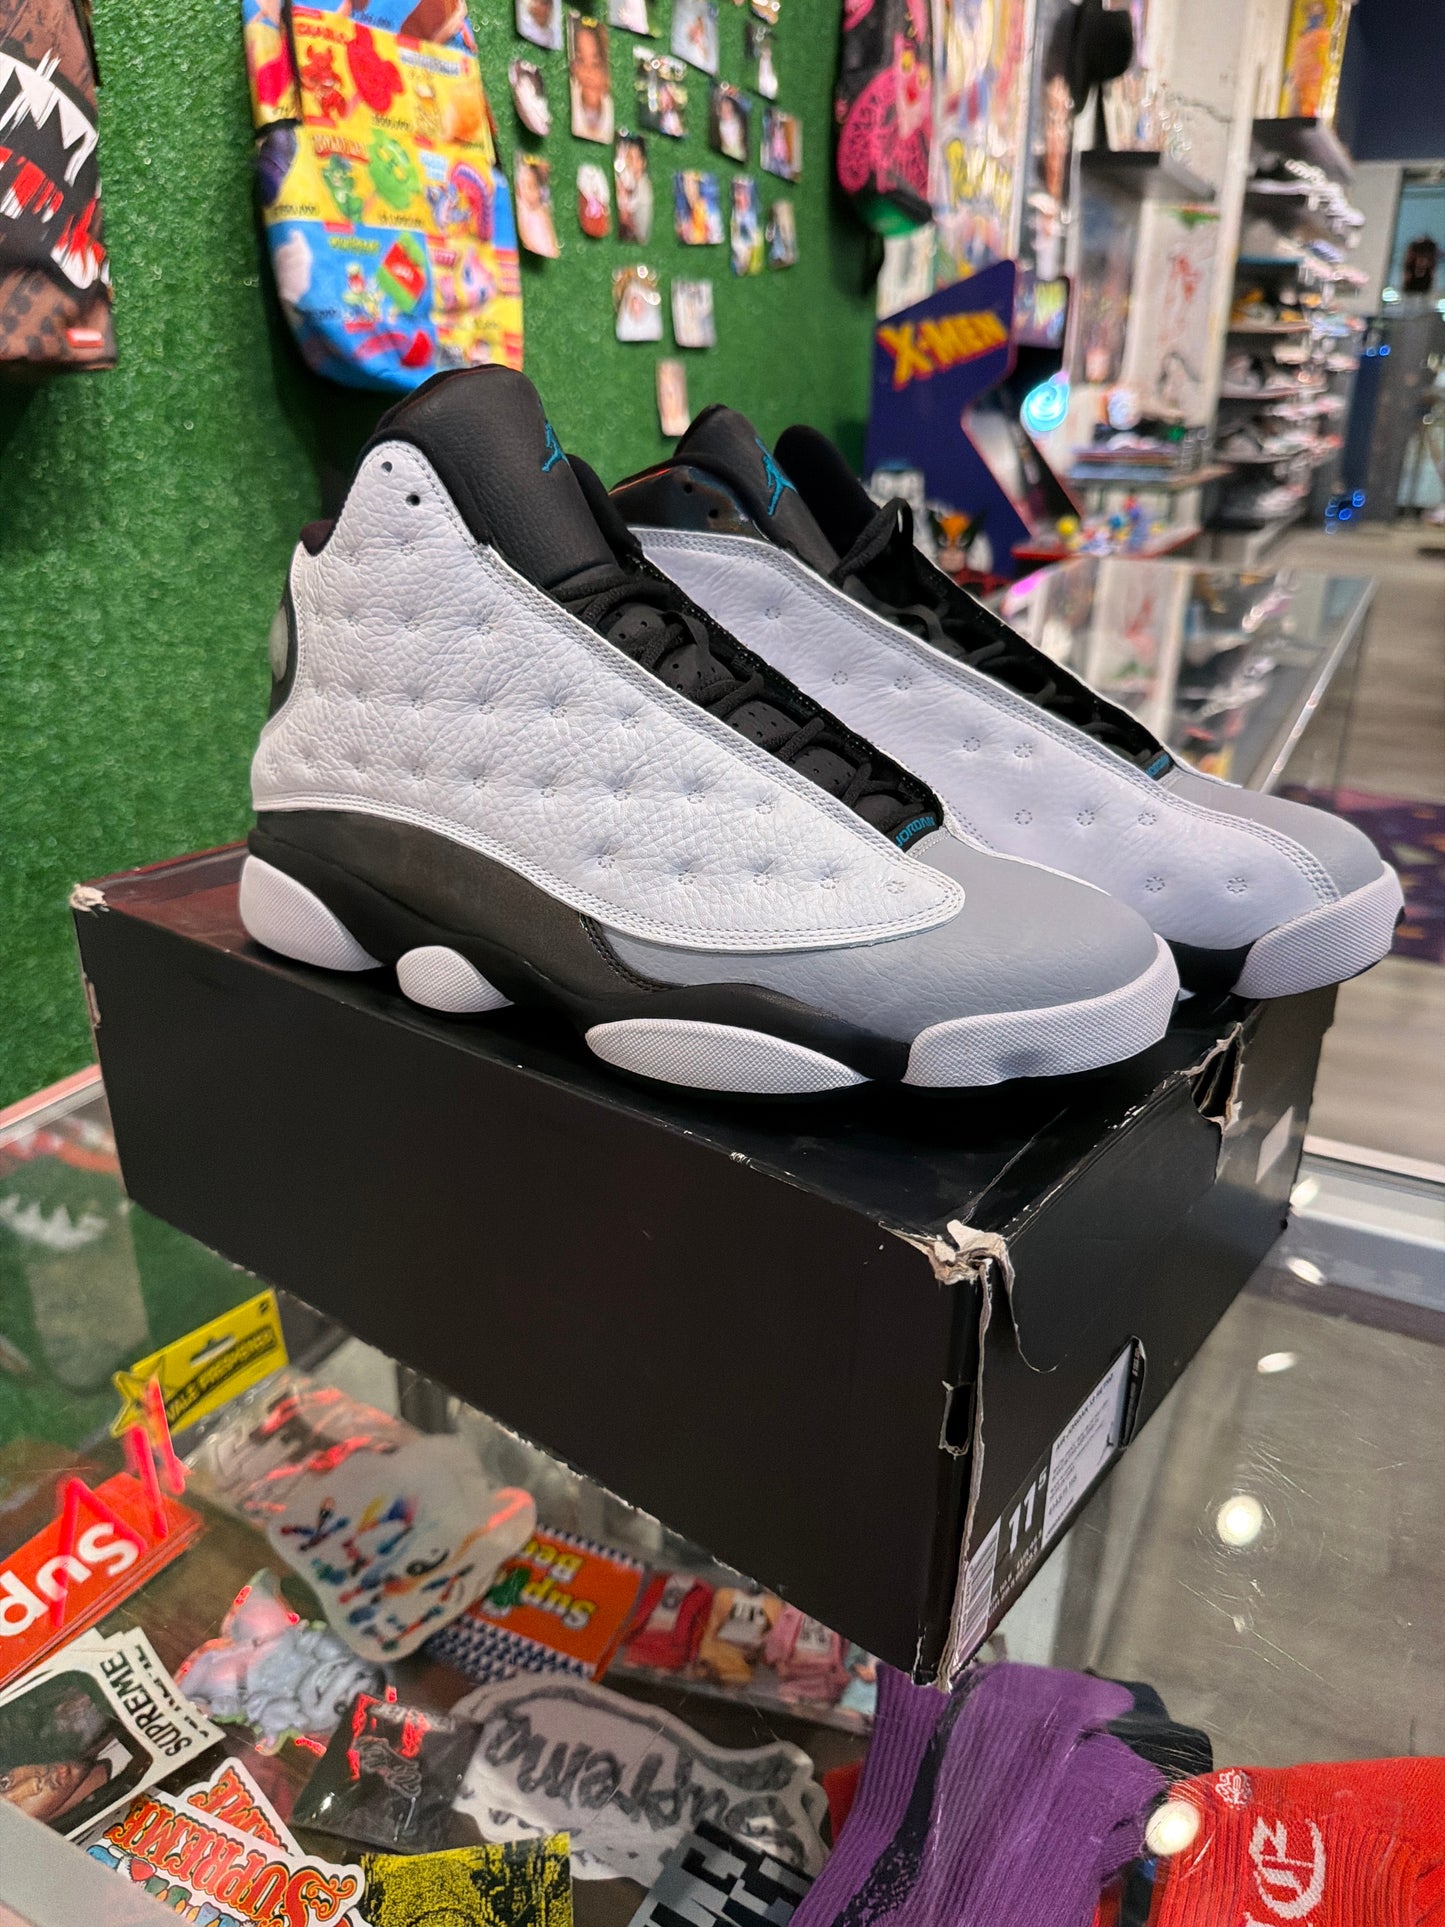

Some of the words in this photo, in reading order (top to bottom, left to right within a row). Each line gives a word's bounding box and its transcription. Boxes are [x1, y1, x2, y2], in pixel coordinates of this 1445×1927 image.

[876, 310, 1008, 391] X-MEN
[895, 815, 936, 847] JORDAN
[99, 1651, 193, 1757] SUPREME
[103, 1793, 357, 1927] SUPREME
